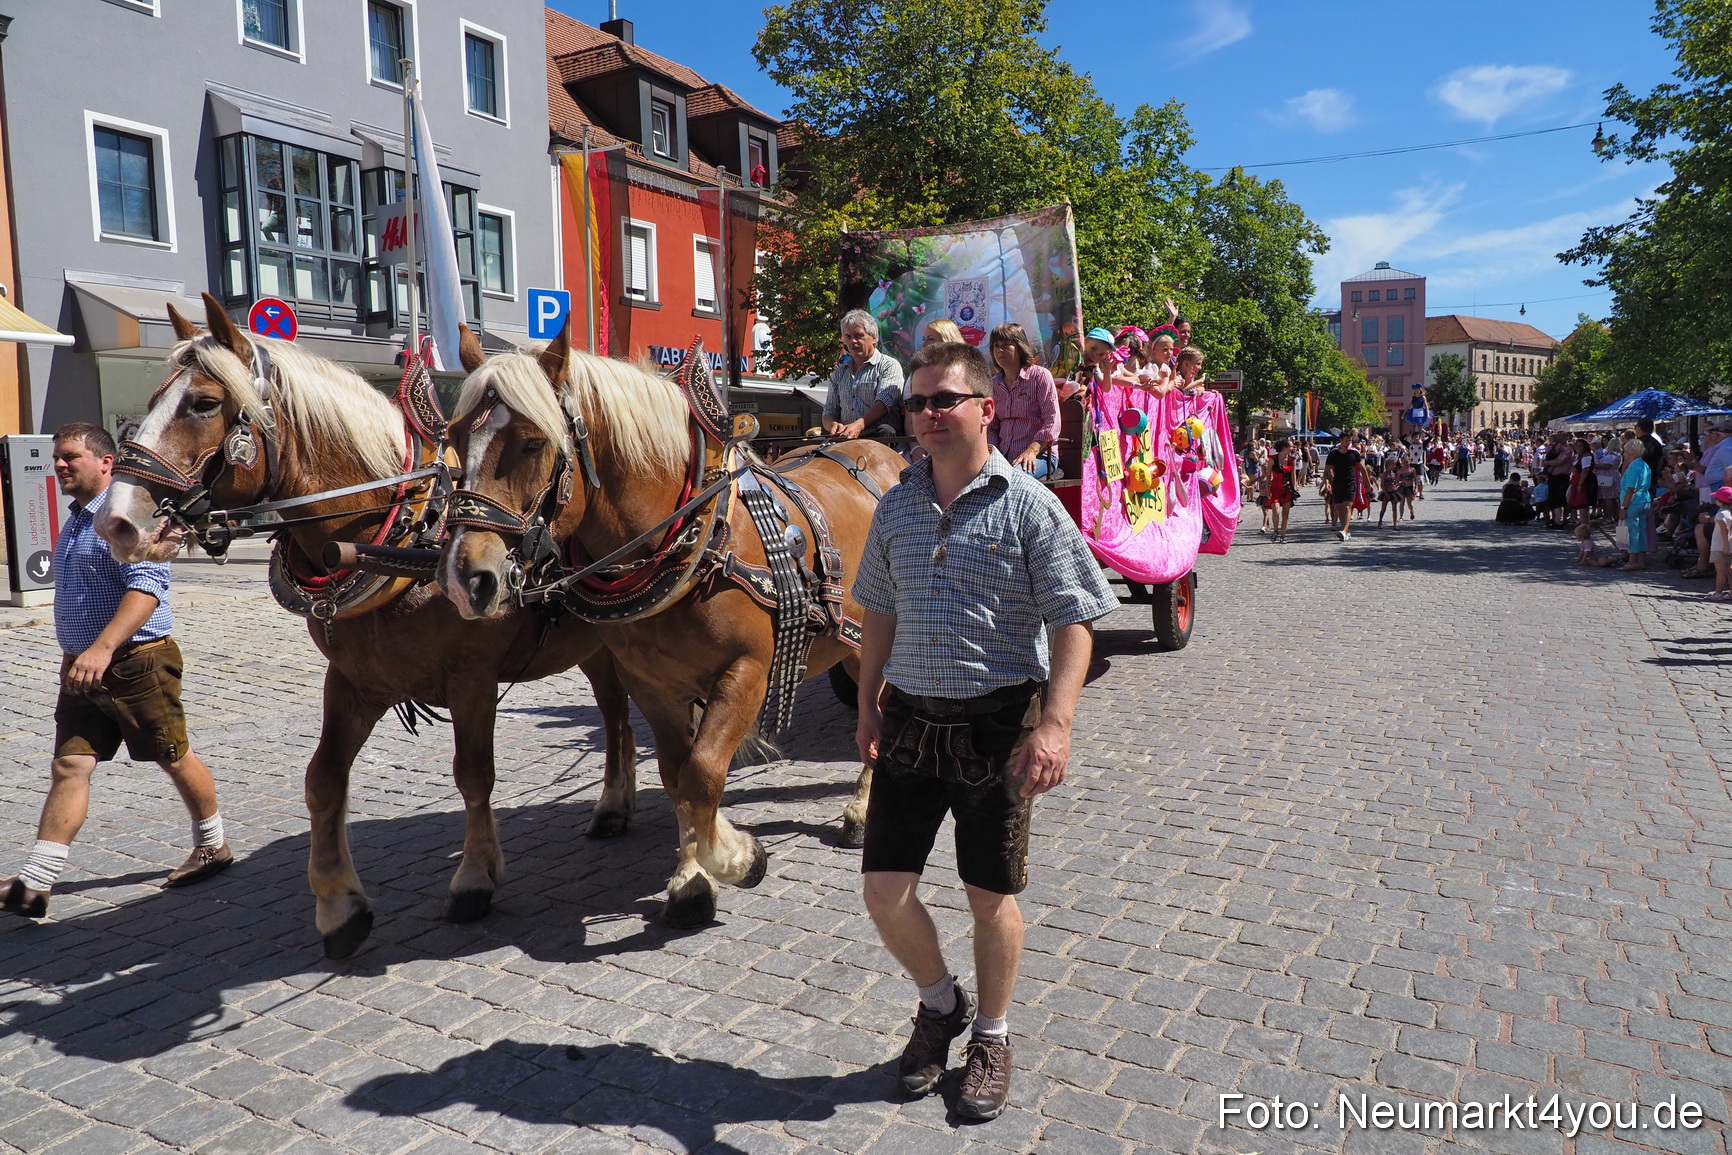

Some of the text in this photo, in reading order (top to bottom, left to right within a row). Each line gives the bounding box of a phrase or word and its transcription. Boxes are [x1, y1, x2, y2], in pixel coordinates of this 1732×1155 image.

[381, 212, 418, 252] H&M
[537, 295, 561, 334] P
[28, 499, 38, 546] Ladestation
[38, 482, 48, 546] für Elektrofahrzeuge
